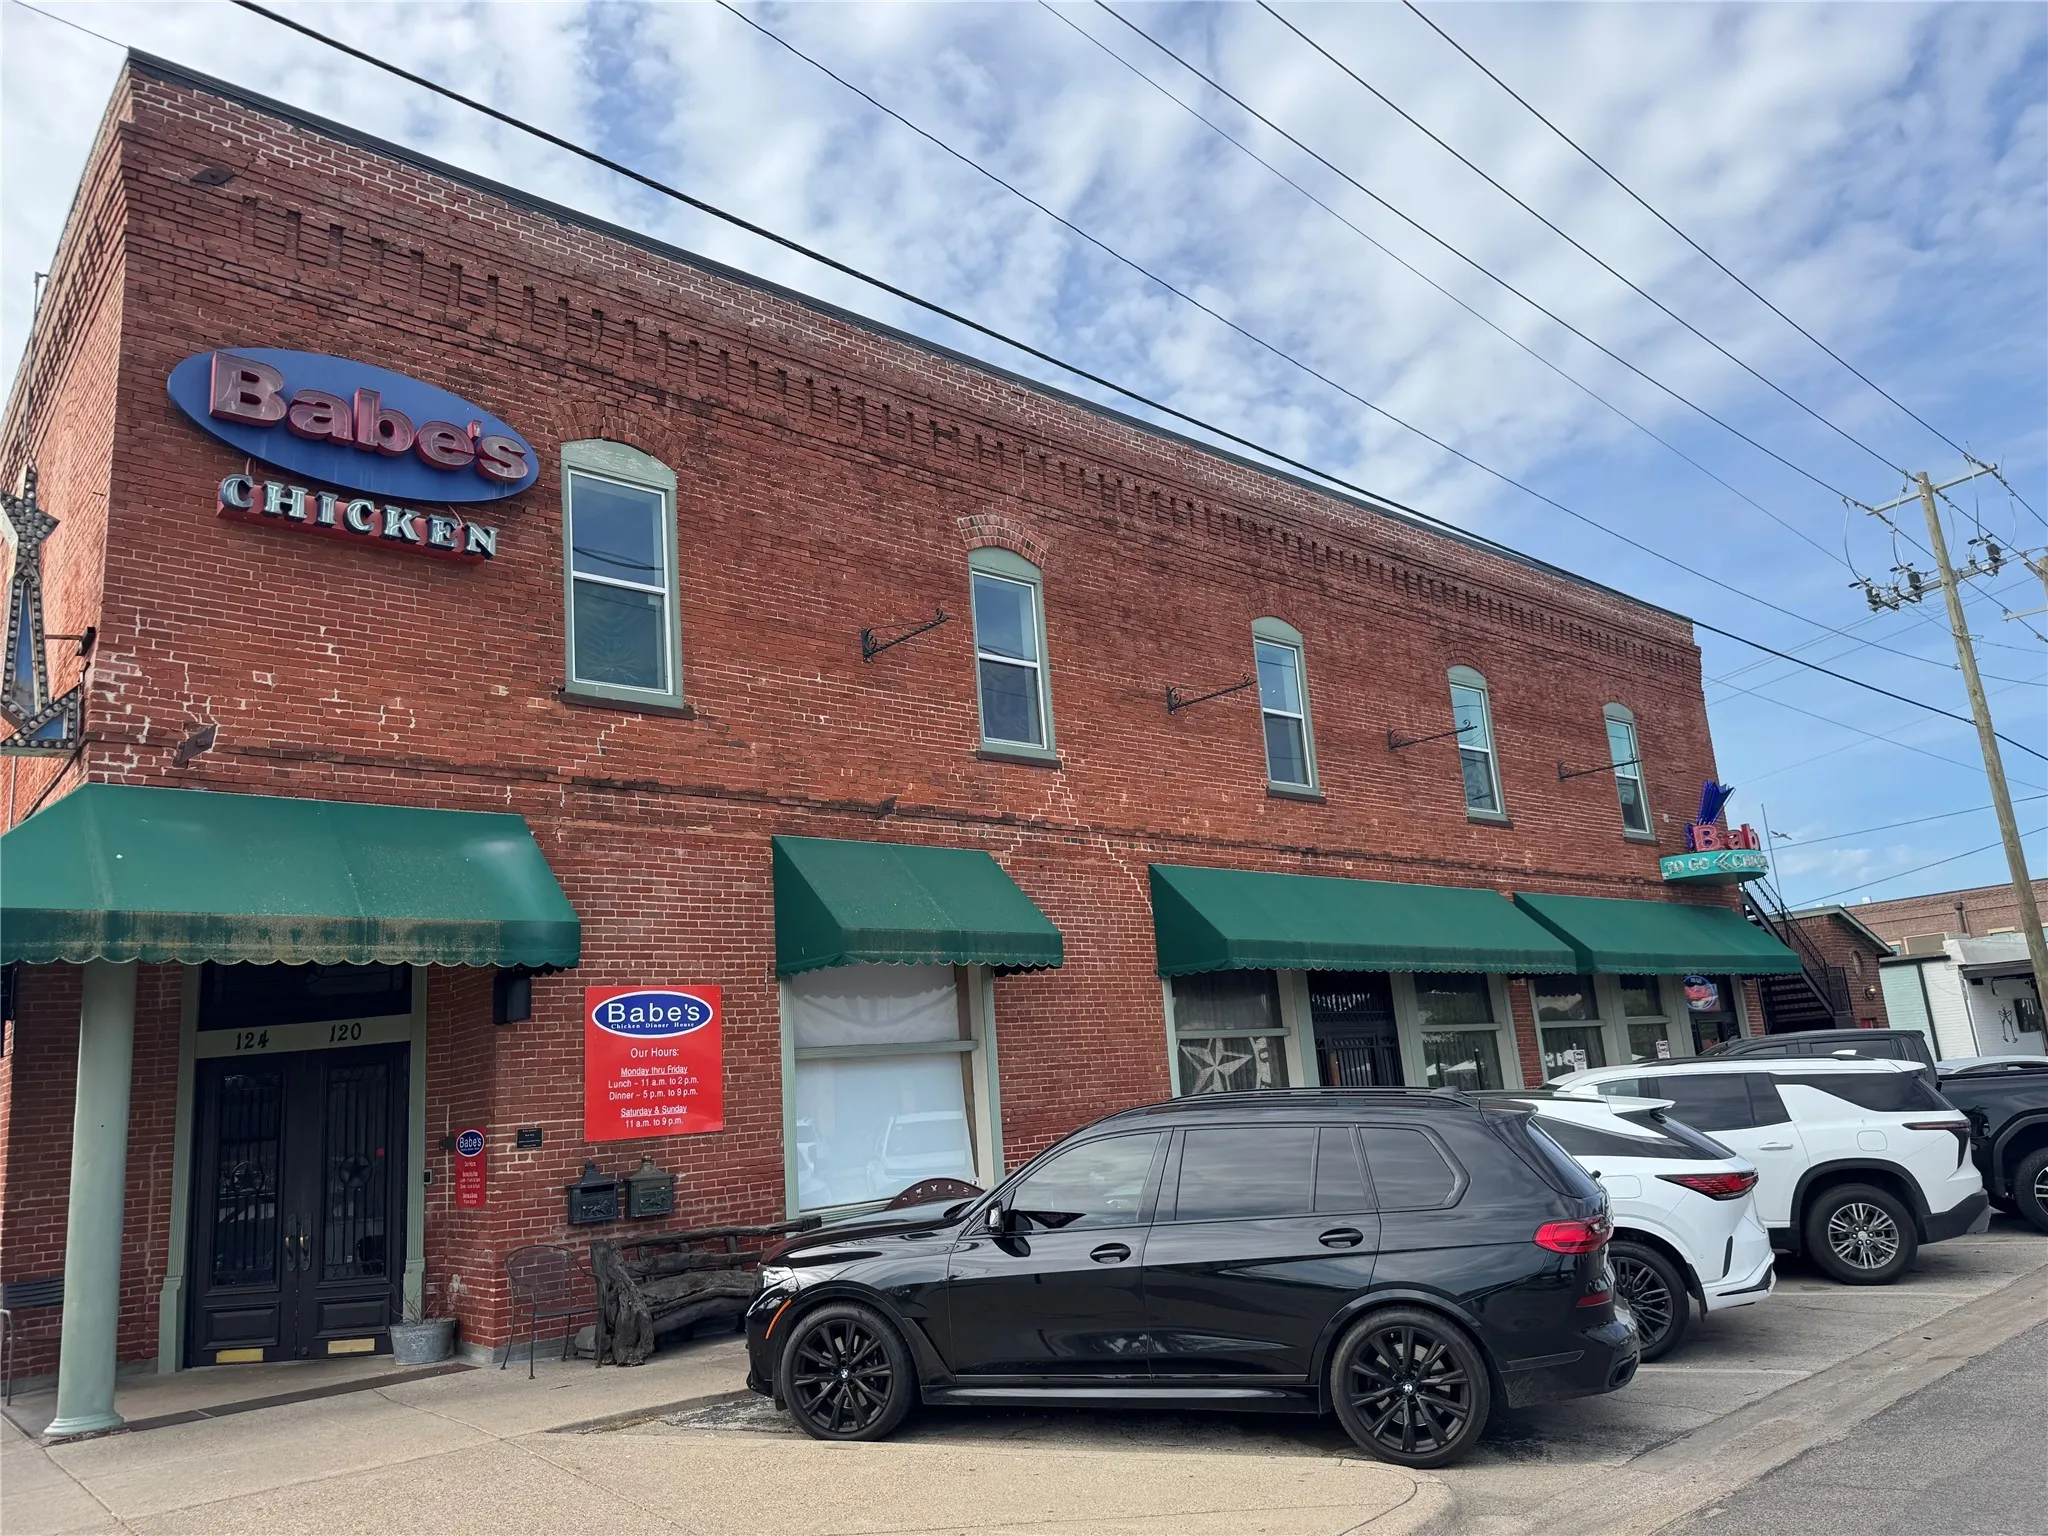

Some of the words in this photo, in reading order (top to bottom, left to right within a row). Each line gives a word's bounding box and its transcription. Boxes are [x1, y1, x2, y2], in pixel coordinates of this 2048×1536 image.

[208, 350, 530, 484] Babe's
[218, 472, 500, 560] CHICKEN
[1664, 859, 1685, 874] TO
[1688, 857, 1710, 871] GO
[608, 1002, 700, 1023] Babe's
[611, 1022, 641, 1030] Chicken
[235, 1029, 270, 1051] 124
[328, 1022, 362, 1043] 120
[630, 1047, 648, 1058] Our
[651, 1046, 680, 1057] Hours:
[621, 1067, 650, 1077] Monday
[651, 1066, 666, 1075] thru
[667, 1065, 688, 1075] Friday
[608, 1079, 632, 1089] Lunch
[641, 1078, 649, 1087] 11
[651, 1078, 667, 1086] a.m.
[669, 1077, 676, 1085] to
[677, 1076, 683, 1085] 2
[684, 1077, 699, 1086] p.m.
[609, 1091, 634, 1100] Dinner
[643, 1090, 648, 1098] 5
[650, 1090, 666, 1099] p.m.
[668, 1089, 675, 1097] to
[676, 1088, 682, 1097] 9
[683, 1088, 698, 1097] p.m.
[621, 1107, 652, 1117] Saturday
[654, 1105, 660, 1115] &
[661, 1104, 688, 1114] Sunday
[626, 1119, 634, 1128] 11
[636, 1119, 651, 1128] a.m.
[653, 1118, 660, 1126] to
[661, 1117, 667, 1126] 9
[668, 1117, 684, 1127] p.m.
[460, 1136, 482, 1148] Babe's
